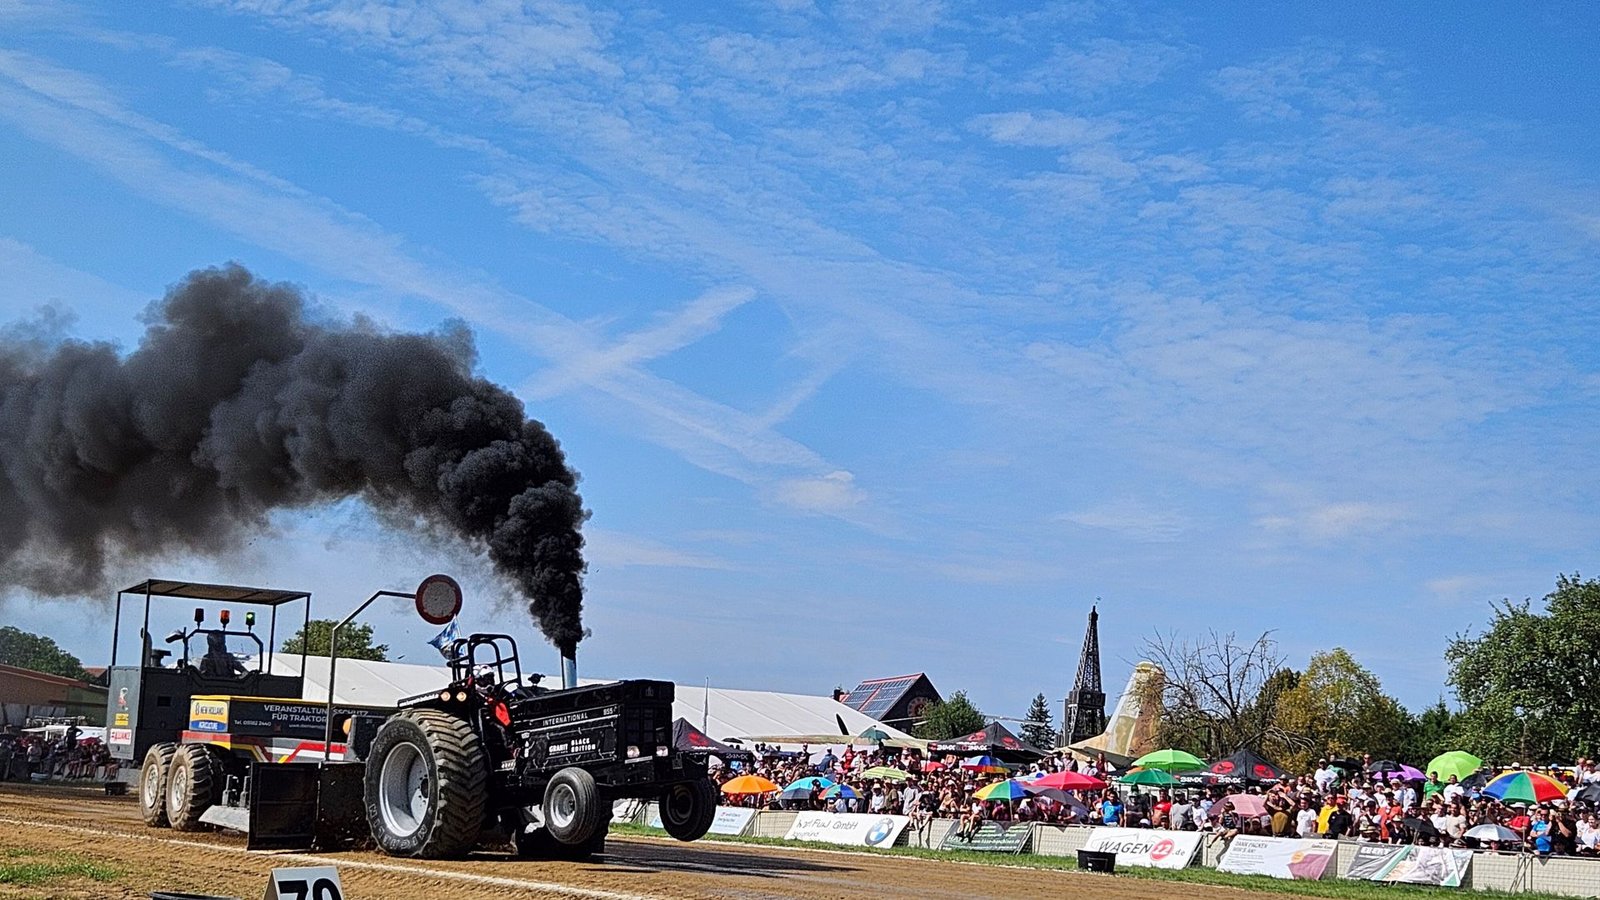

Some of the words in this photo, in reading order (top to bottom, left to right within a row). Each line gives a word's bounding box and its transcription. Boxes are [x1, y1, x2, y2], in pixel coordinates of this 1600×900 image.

[264, 705, 369, 717] VERANSTALTUNSSCHUTZ
[272, 712, 288, 721] FÜR
[290, 714, 328, 723] TRAKTOR
[542, 712, 589, 727] INTERNATIONAL
[570, 737, 590, 746] BLACK
[548, 743, 569, 752] GRANIT
[570, 743, 596, 753] EDITION
